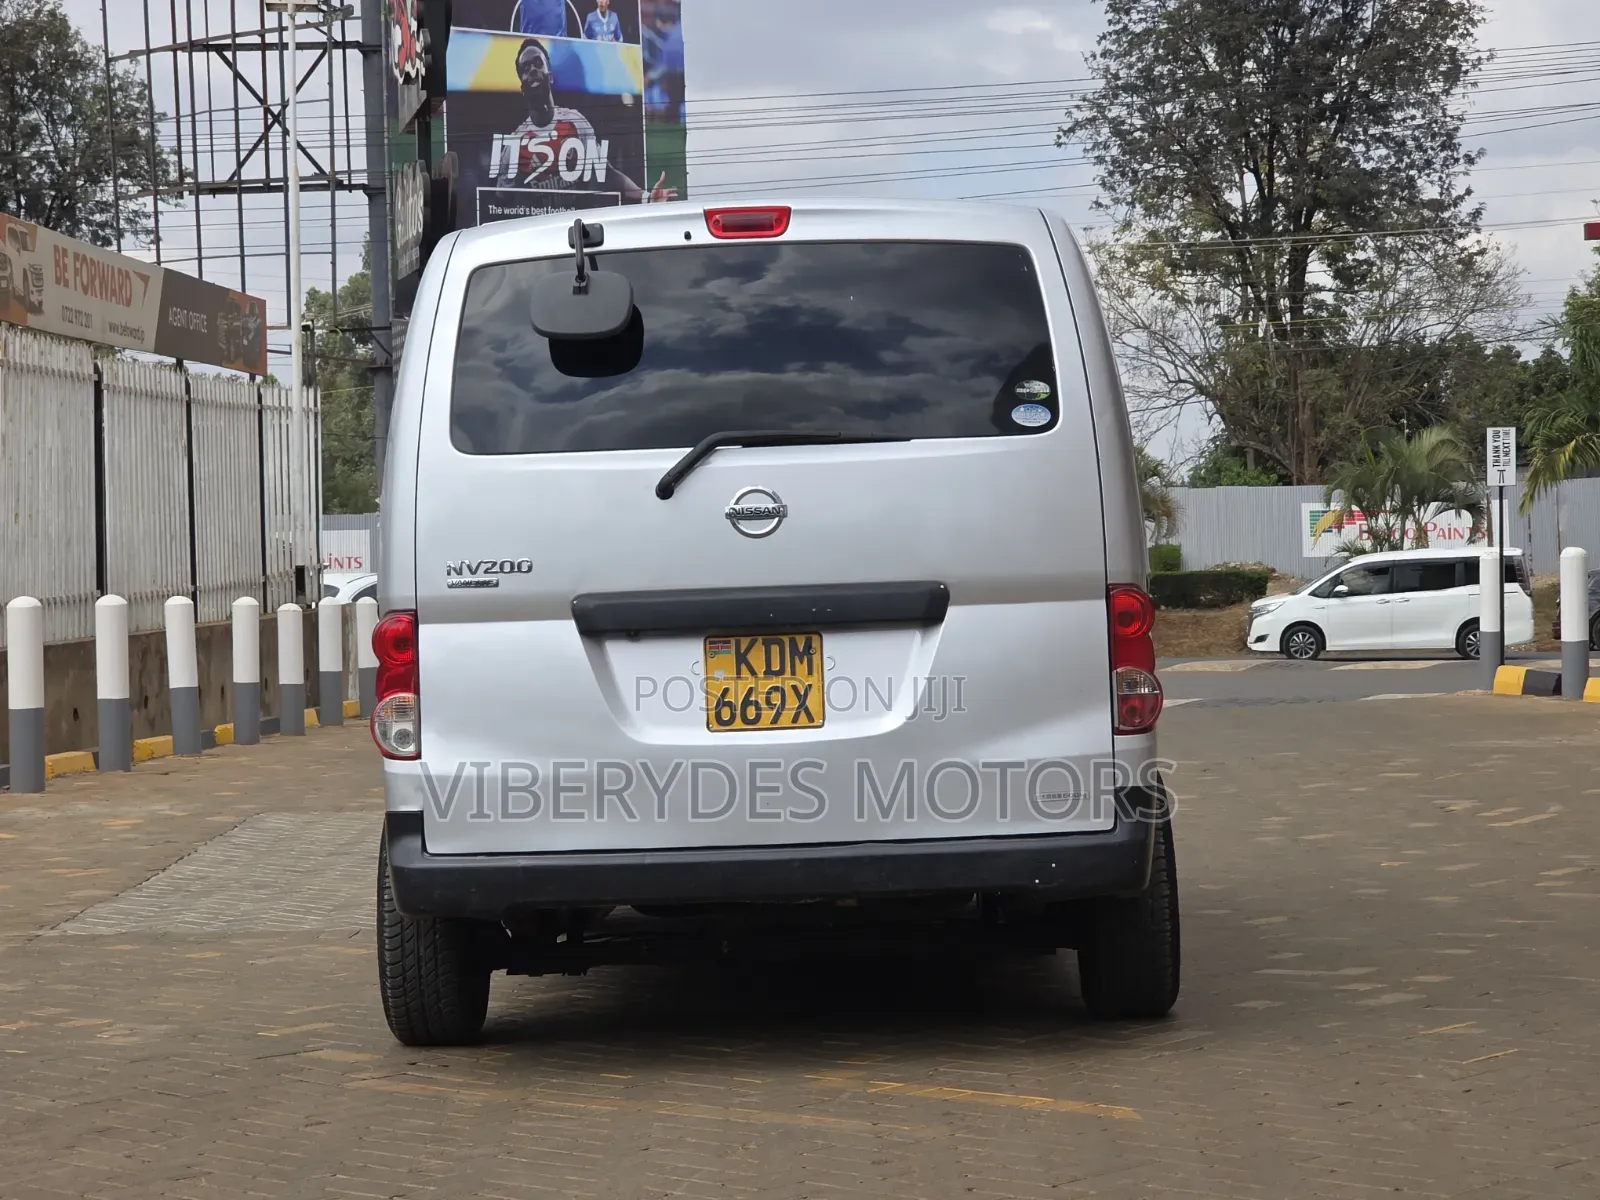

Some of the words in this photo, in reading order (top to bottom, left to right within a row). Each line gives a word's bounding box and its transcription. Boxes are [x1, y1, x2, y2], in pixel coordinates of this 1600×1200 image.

[488, 130, 559, 184] IT'S
[558, 137, 609, 183] ON
[488, 205, 503, 215] The
[503, 205, 530, 215] world's
[531, 205, 547, 216] best
[548, 206, 576, 216] footb
[53, 244, 69, 287] BE
[73, 251, 133, 308] FORWARD
[61, 304, 74, 324] 0722
[168, 306, 187, 329] AGENT
[188, 311, 208, 334] OFFICE
[1492, 429, 1501, 444] YOU
[1502, 428, 1511, 441] TIME
[1492, 444, 1501, 468] THANK
[1502, 442, 1511, 458] NEXT
[1502, 458, 1511, 467] TILL
[729, 506, 781, 517] NISSAN
[446, 558, 533, 576] NV200
[734, 636, 814, 679] KDM
[714, 683, 816, 727] 669X
